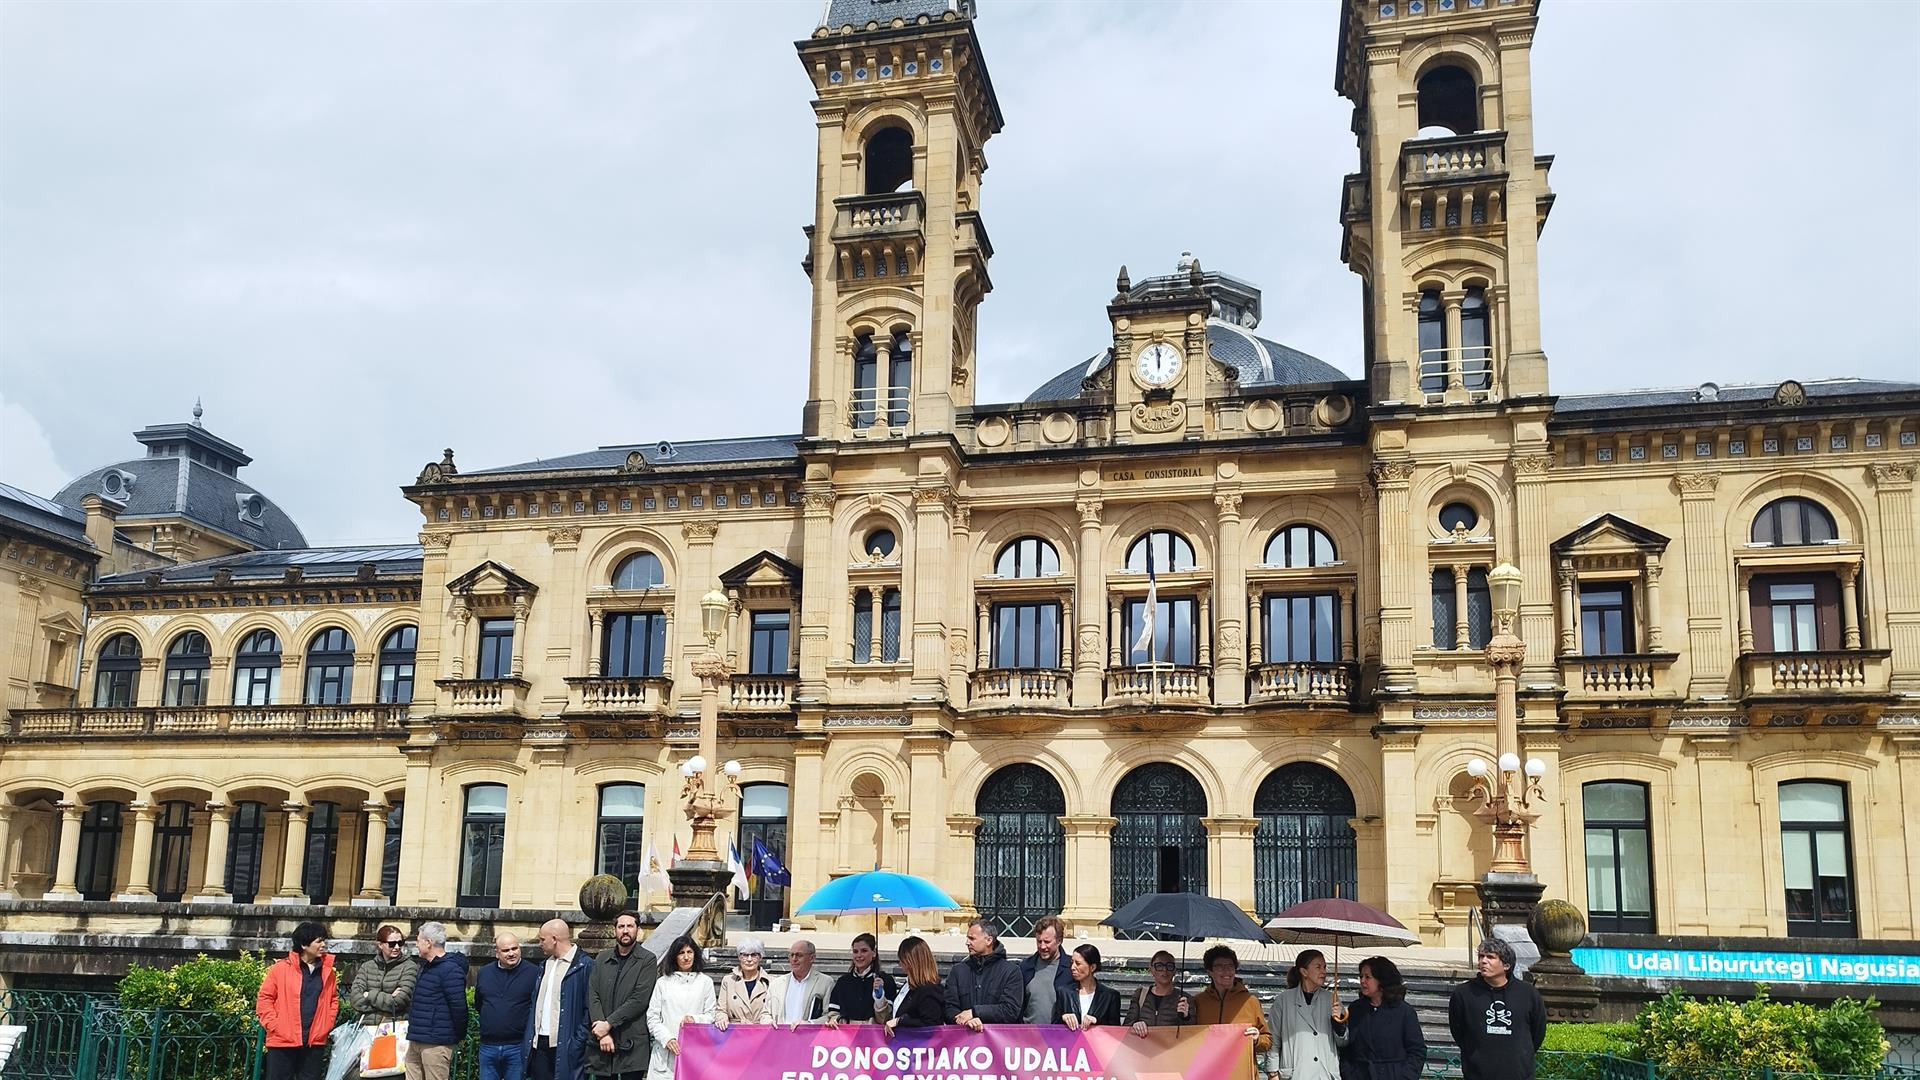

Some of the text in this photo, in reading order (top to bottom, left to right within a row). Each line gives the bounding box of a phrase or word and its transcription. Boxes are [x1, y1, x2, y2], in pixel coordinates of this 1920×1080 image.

[1113, 468, 1203, 481] CASA CONSISTORIAL
[1627, 953, 1920, 981] Udal Liburutegi Nagusia
[812, 1045, 1091, 1073] DONOSTIAKO UDALA
